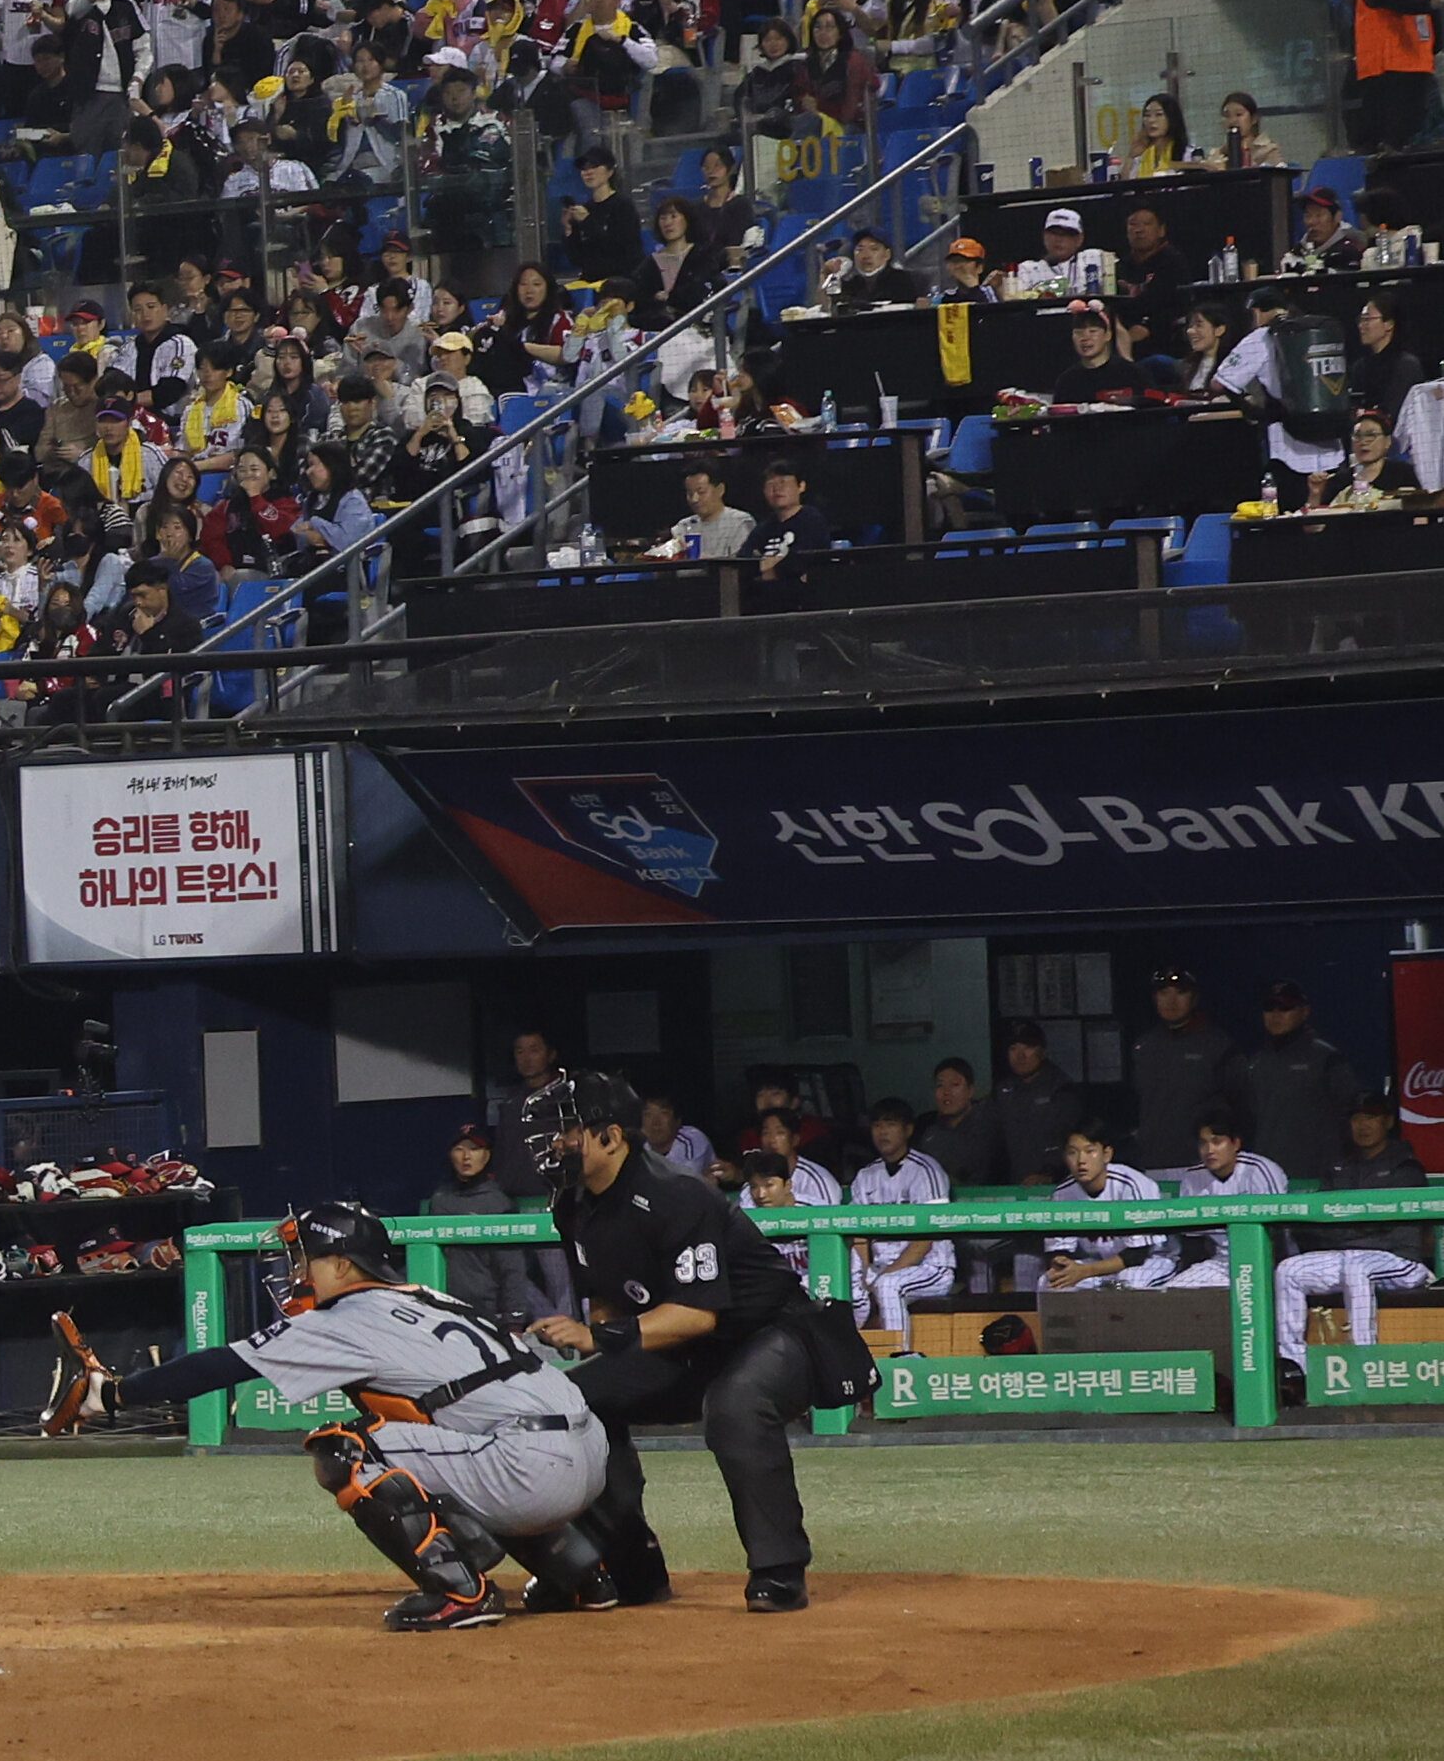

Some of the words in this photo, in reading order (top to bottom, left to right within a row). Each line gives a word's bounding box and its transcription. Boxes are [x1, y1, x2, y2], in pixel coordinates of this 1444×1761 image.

[93, 813, 180, 857] 승리를
[188, 809, 261, 855] 향해,
[775, 804, 935, 866] 신한
[79, 866, 167, 908] 하나의
[175, 861, 278, 904] 트윈스!
[152, 934, 166, 947] LG
[169, 932, 204, 946] TWINS
[674, 1242, 719, 1284] 33
[1236, 1263, 1254, 1326] Rakuten
[193, 1290, 208, 1349] Rakuten
[1241, 1327, 1257, 1372] Travel
[927, 1373, 973, 1401] 일본
[979, 1371, 1048, 1400] 여행은
[1054, 1369, 1123, 1397] 라쿠텐
[1129, 1367, 1197, 1395] 트래블
[1362, 1359, 1411, 1388] 일본
